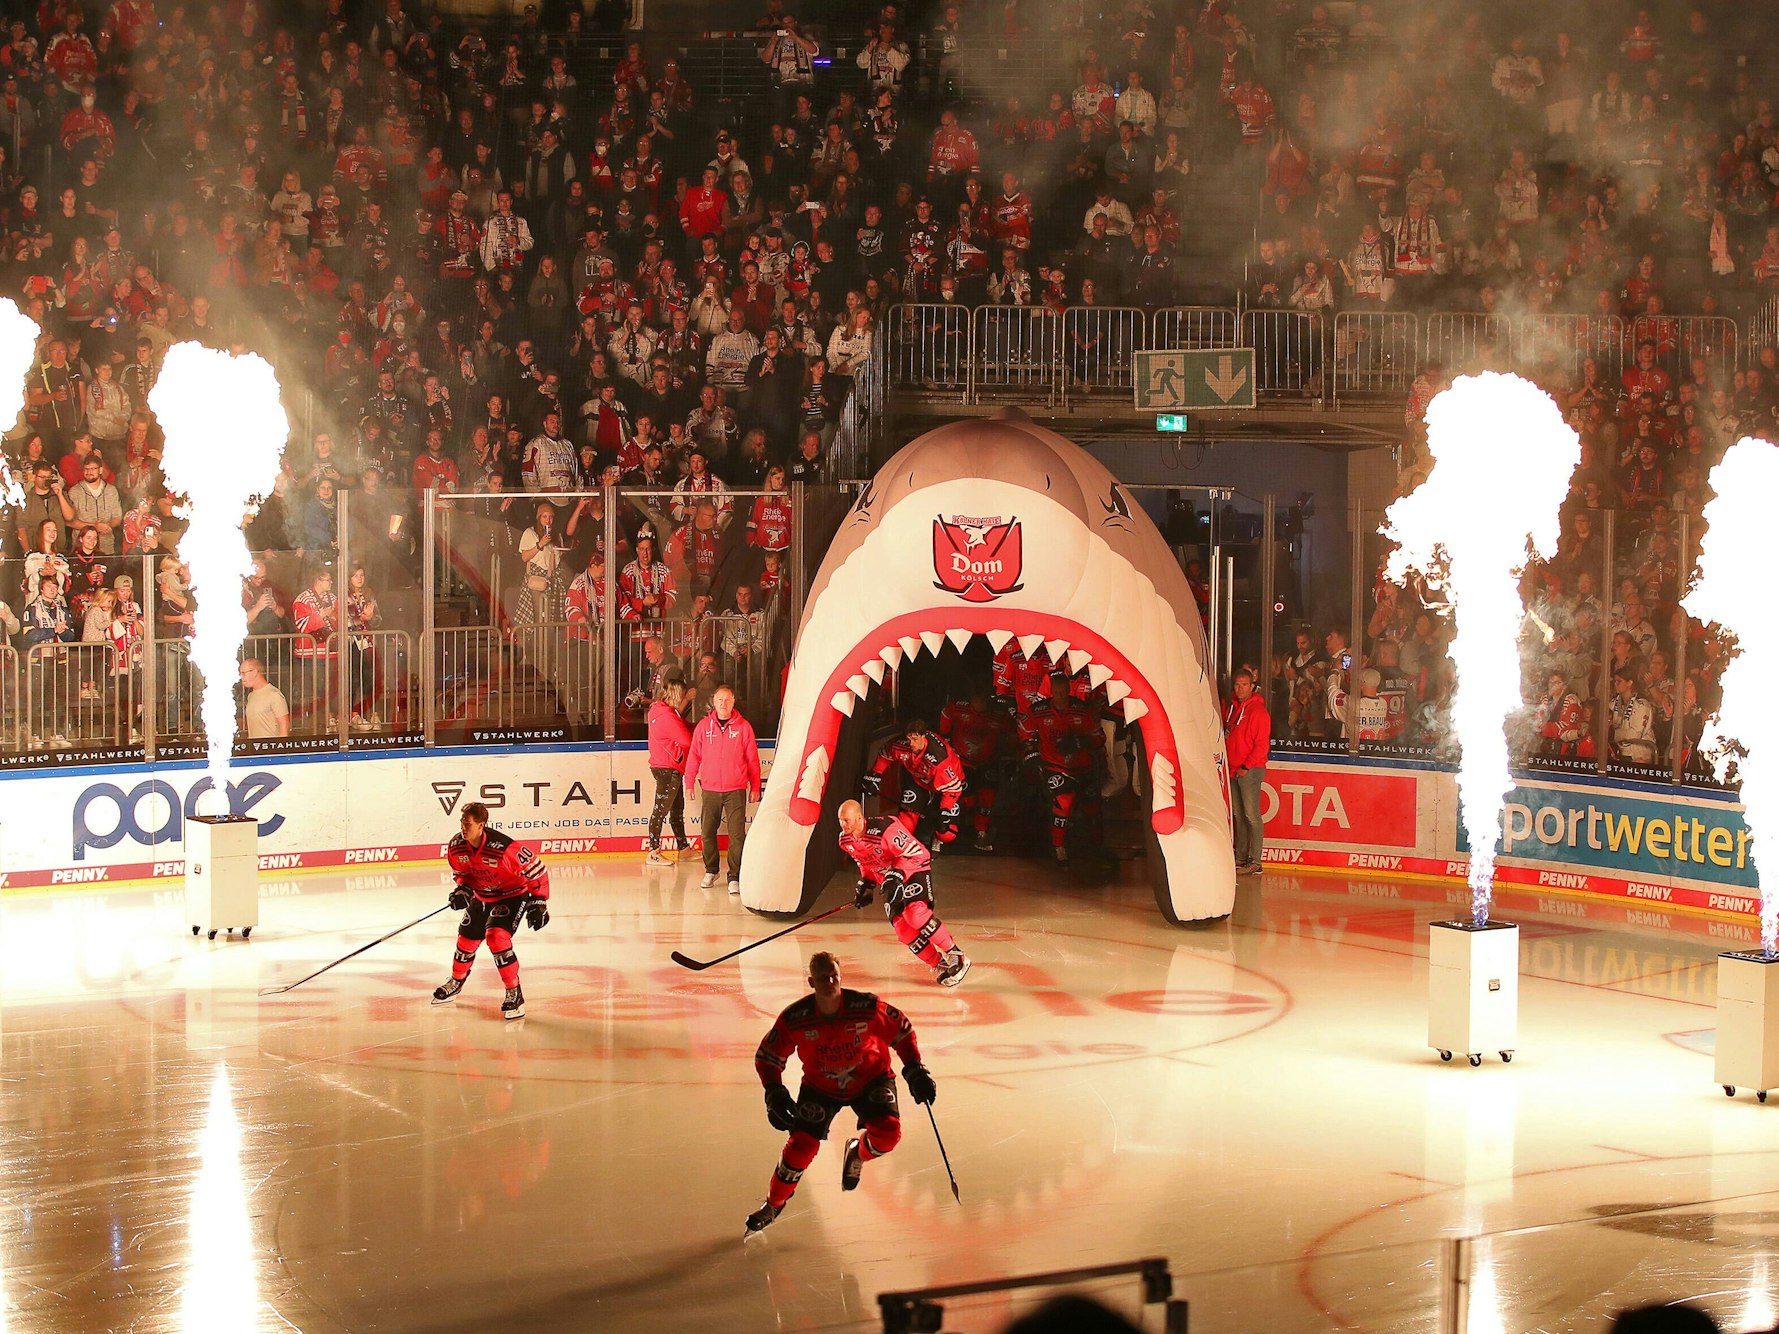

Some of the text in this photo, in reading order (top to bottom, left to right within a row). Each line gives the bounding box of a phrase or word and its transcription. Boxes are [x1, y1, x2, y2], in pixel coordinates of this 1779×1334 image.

[951, 552, 1002, 574] Dom
[2, 754, 49, 765] LWERK®
[508, 819, 550, 829] JEDEN
[555, 819, 580, 828] JOB
[585, 818, 610, 827] DAS
[540, 838, 598, 853] PENNY.
[893, 829, 909, 849] 24
[258, 853, 303, 870] ENNY.
[345, 847, 399, 864] PENNY.
[516, 846, 533, 864] 40
[1260, 848, 1304, 862] ENNY.
[1348, 853, 1402, 870] PENNY.
[51, 866, 109, 884] PENNY.
[152, 861, 185, 877] PEN
[1538, 871, 1589, 890] PENNY.
[1627, 882, 1673, 901] PENNY.
[1708, 894, 1755, 914] PENNY.
